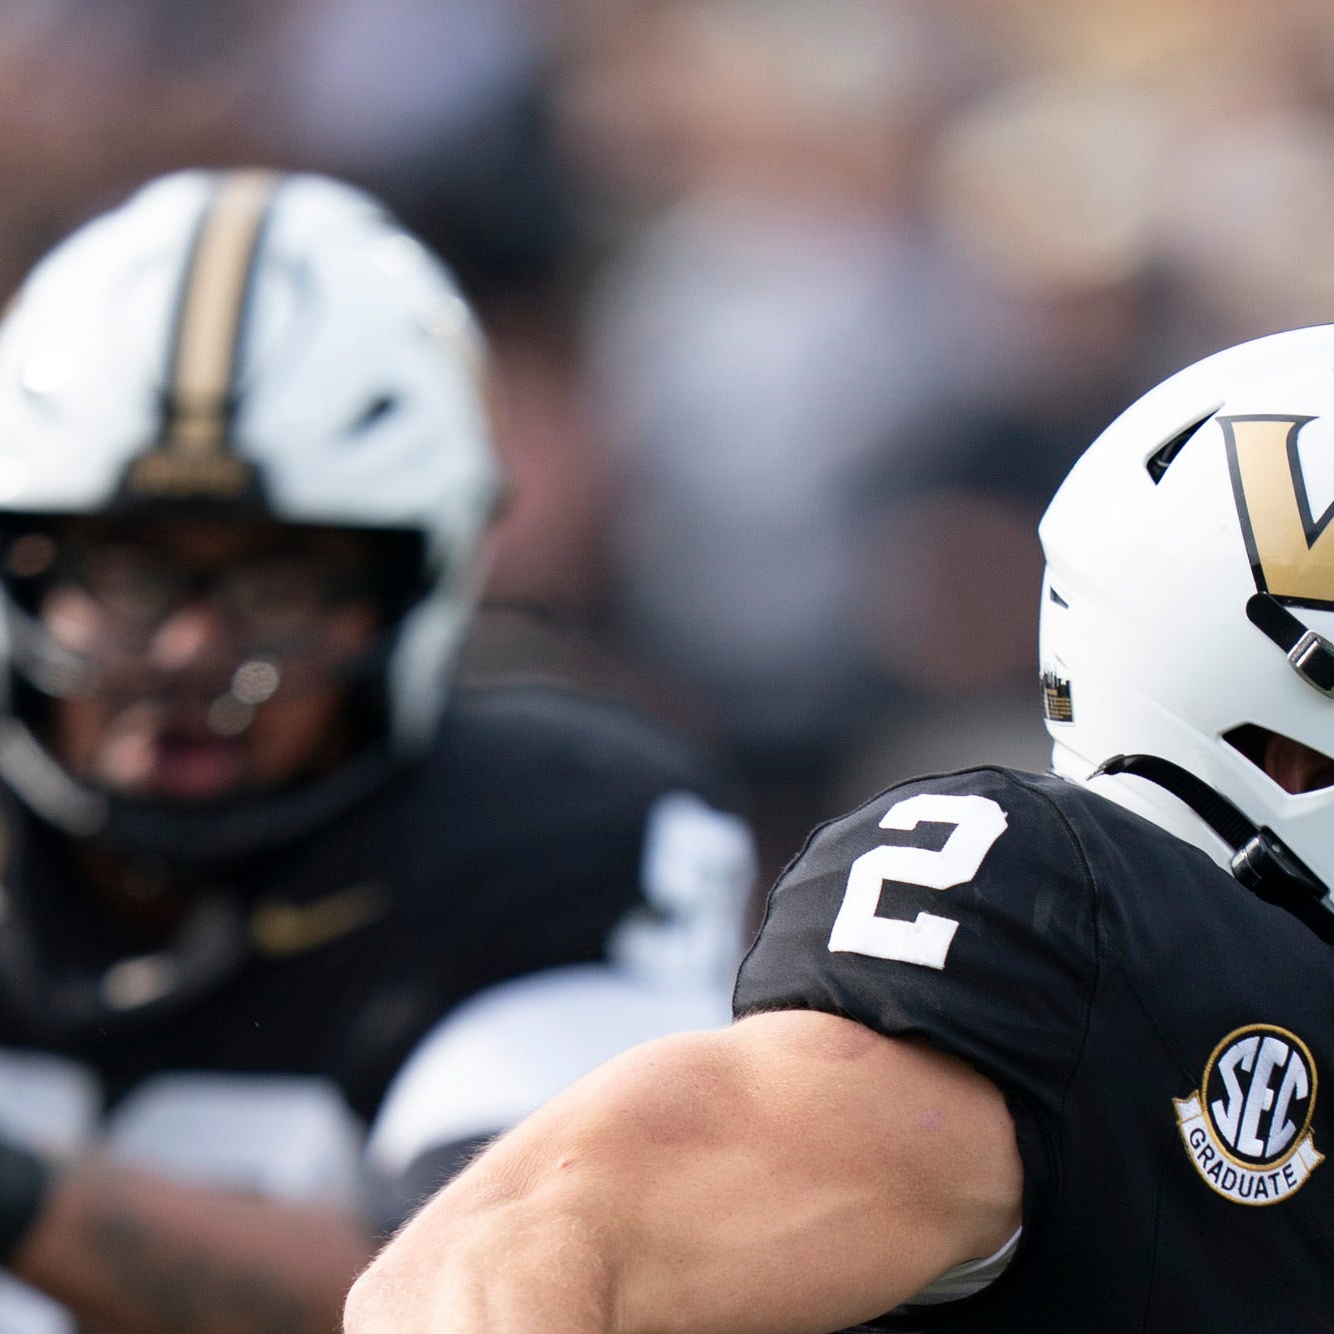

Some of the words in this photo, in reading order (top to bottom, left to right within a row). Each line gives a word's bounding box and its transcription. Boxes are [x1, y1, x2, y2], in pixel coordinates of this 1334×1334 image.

[827, 793, 1009, 971] 2
[1211, 1036, 1309, 1158] SEC
[1189, 1127, 1298, 1199] GRADUATE
